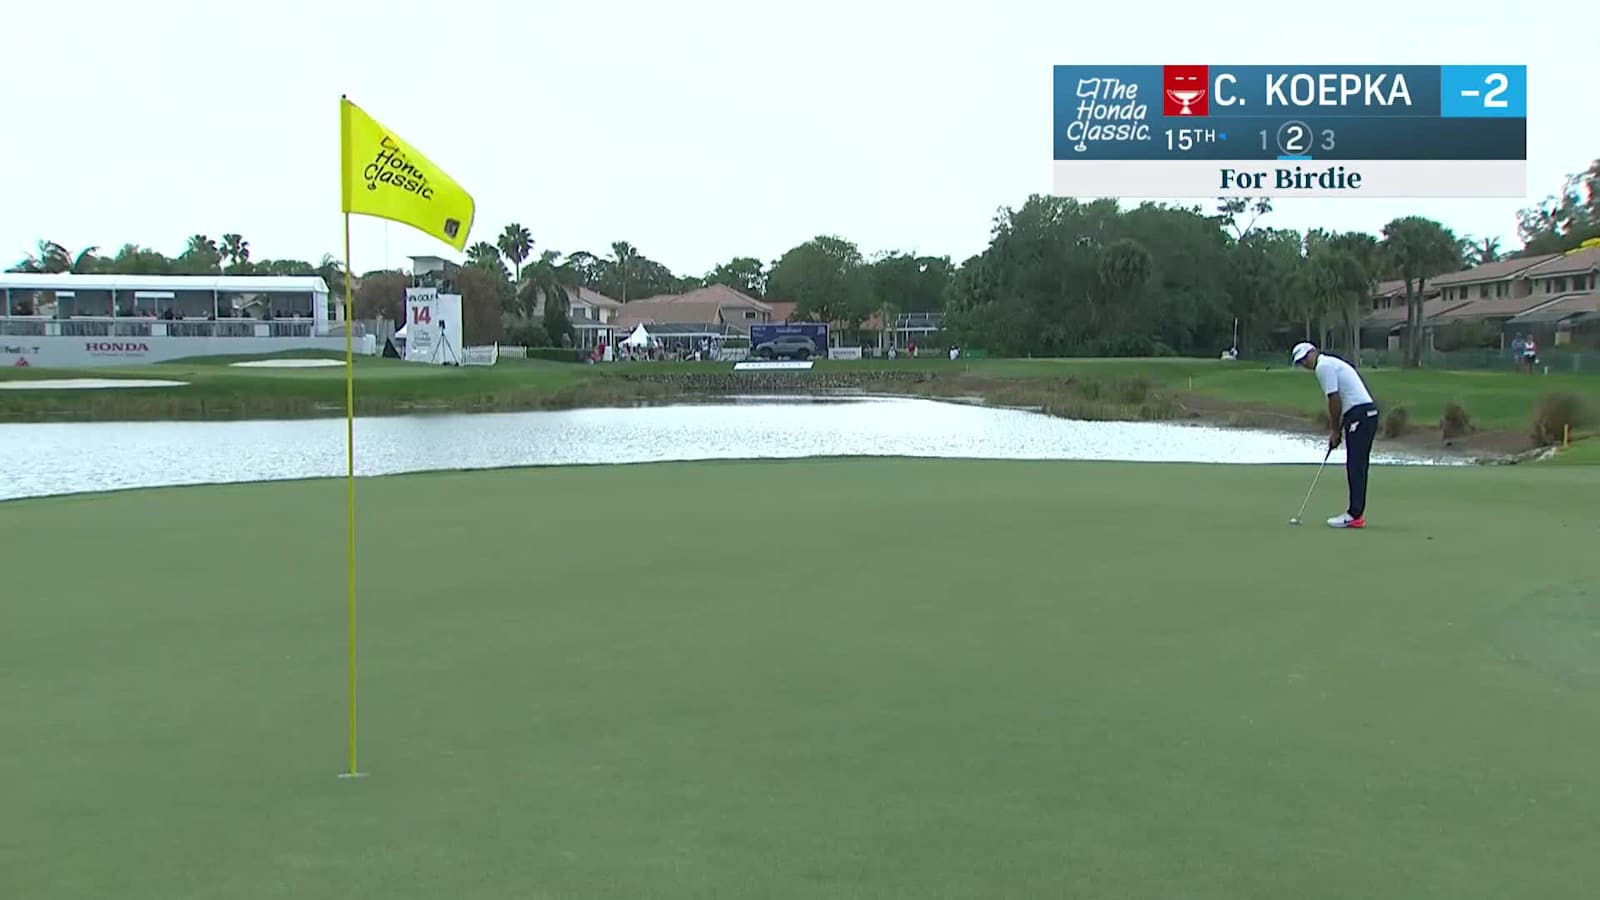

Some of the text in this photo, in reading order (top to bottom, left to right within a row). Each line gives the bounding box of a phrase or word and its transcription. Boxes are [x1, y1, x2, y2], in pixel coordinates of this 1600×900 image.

[364, 163, 434, 200] Classic
[411, 305, 431, 325] 14
[86, 342, 150, 352] HONDA
